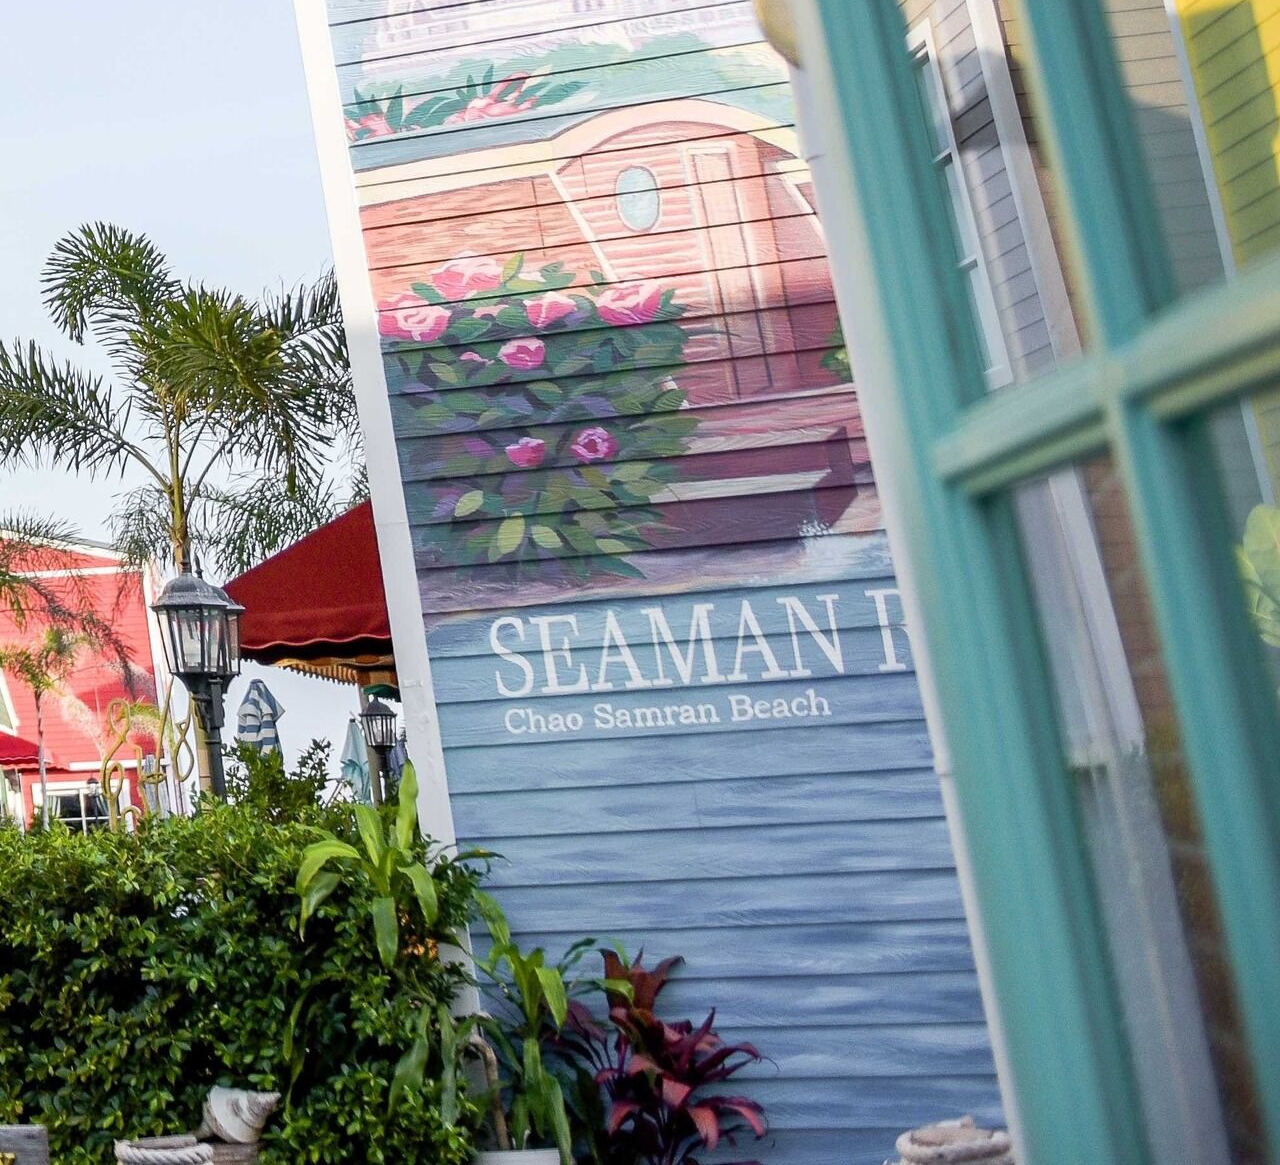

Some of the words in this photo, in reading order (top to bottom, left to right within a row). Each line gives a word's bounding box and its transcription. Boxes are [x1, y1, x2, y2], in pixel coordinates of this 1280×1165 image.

[488, 593, 846, 698] SEAMAN
[504, 707, 584, 735] Chao
[593, 702, 721, 729] Samran
[727, 688, 833, 722] Beach
